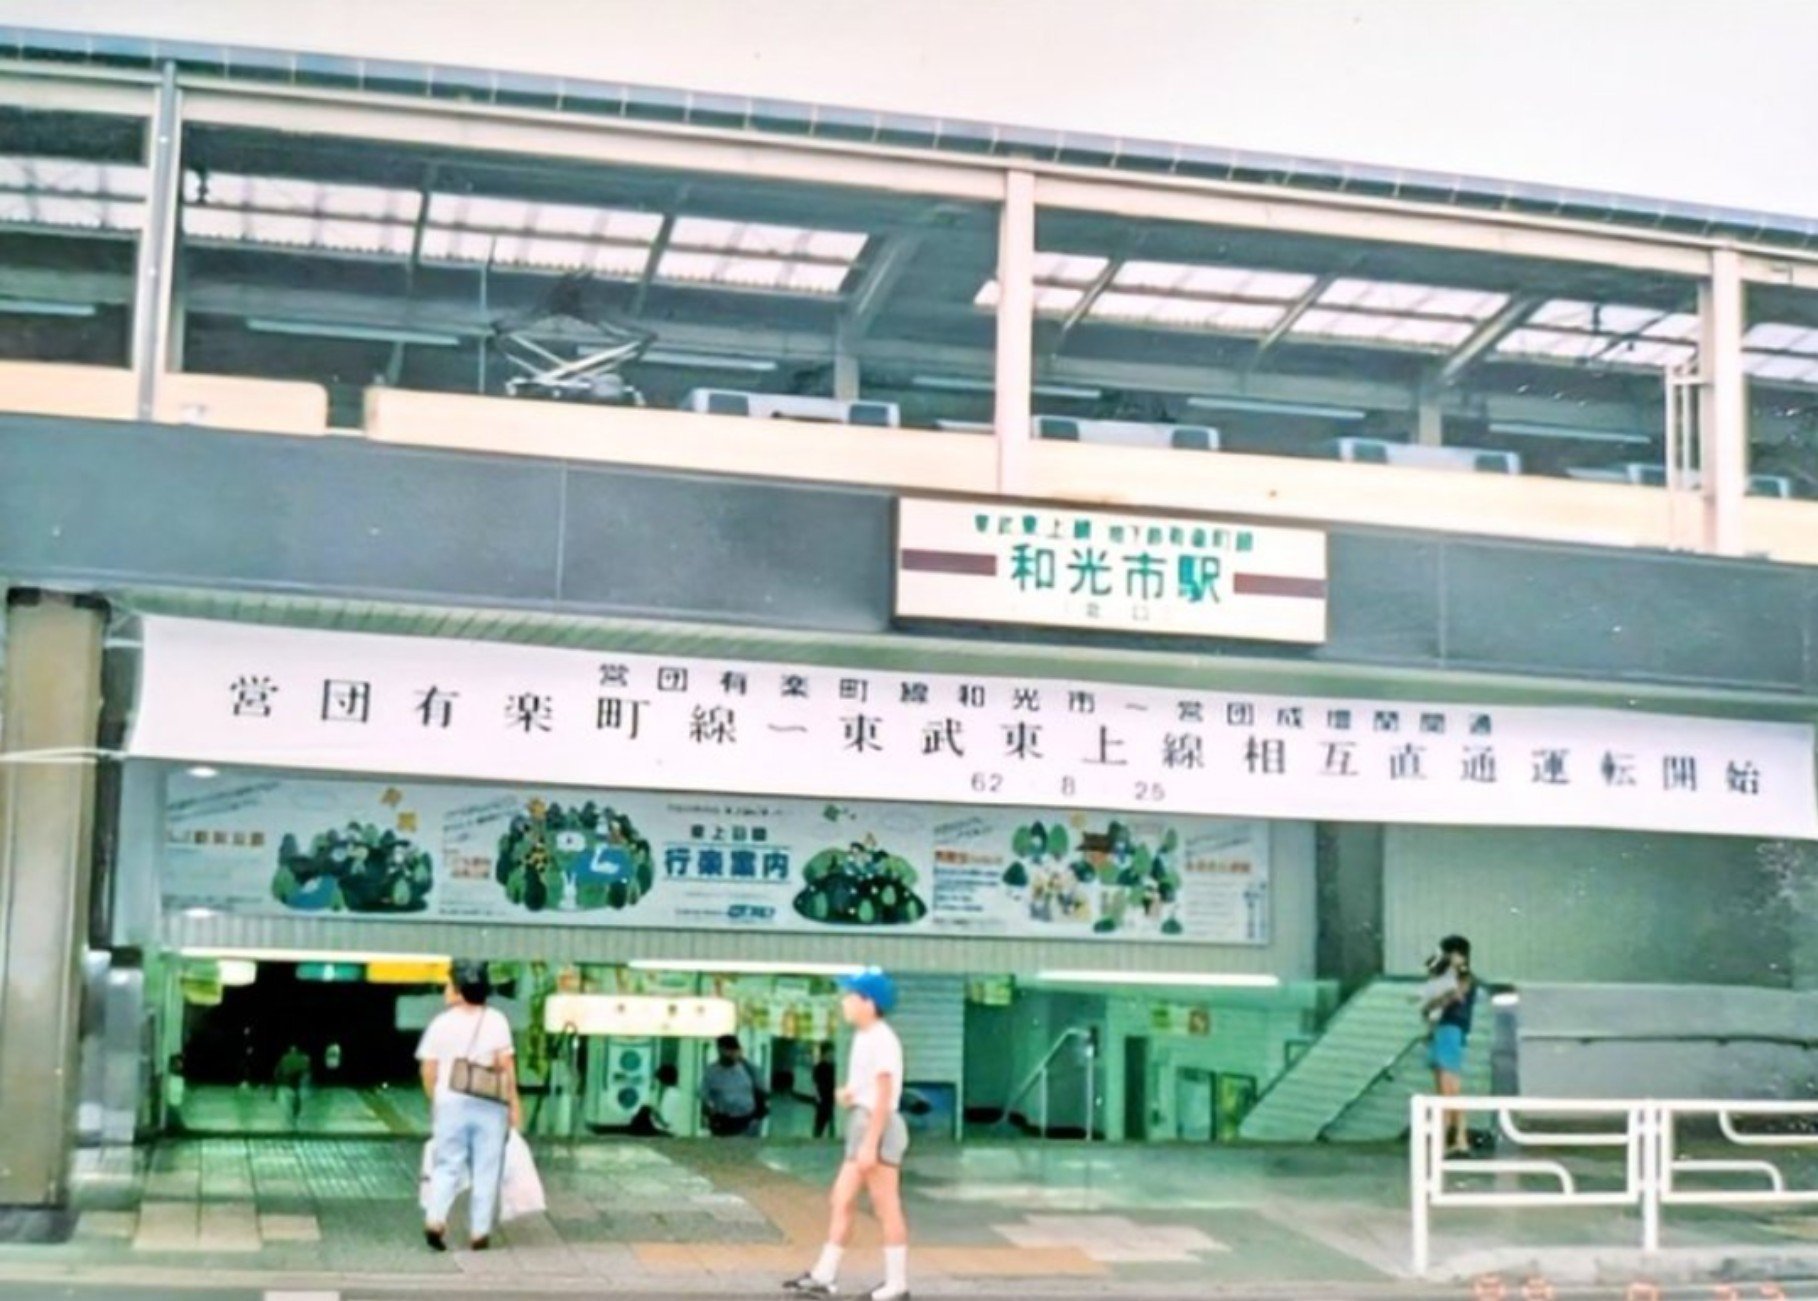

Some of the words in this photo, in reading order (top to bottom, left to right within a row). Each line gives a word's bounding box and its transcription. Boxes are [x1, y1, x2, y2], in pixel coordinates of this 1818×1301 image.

[1010, 543, 1221, 604] 和光市駅
[971, 772, 1003, 792] 62
[1061, 776, 1076, 796] 8
[1135, 781, 1166, 801] 25
